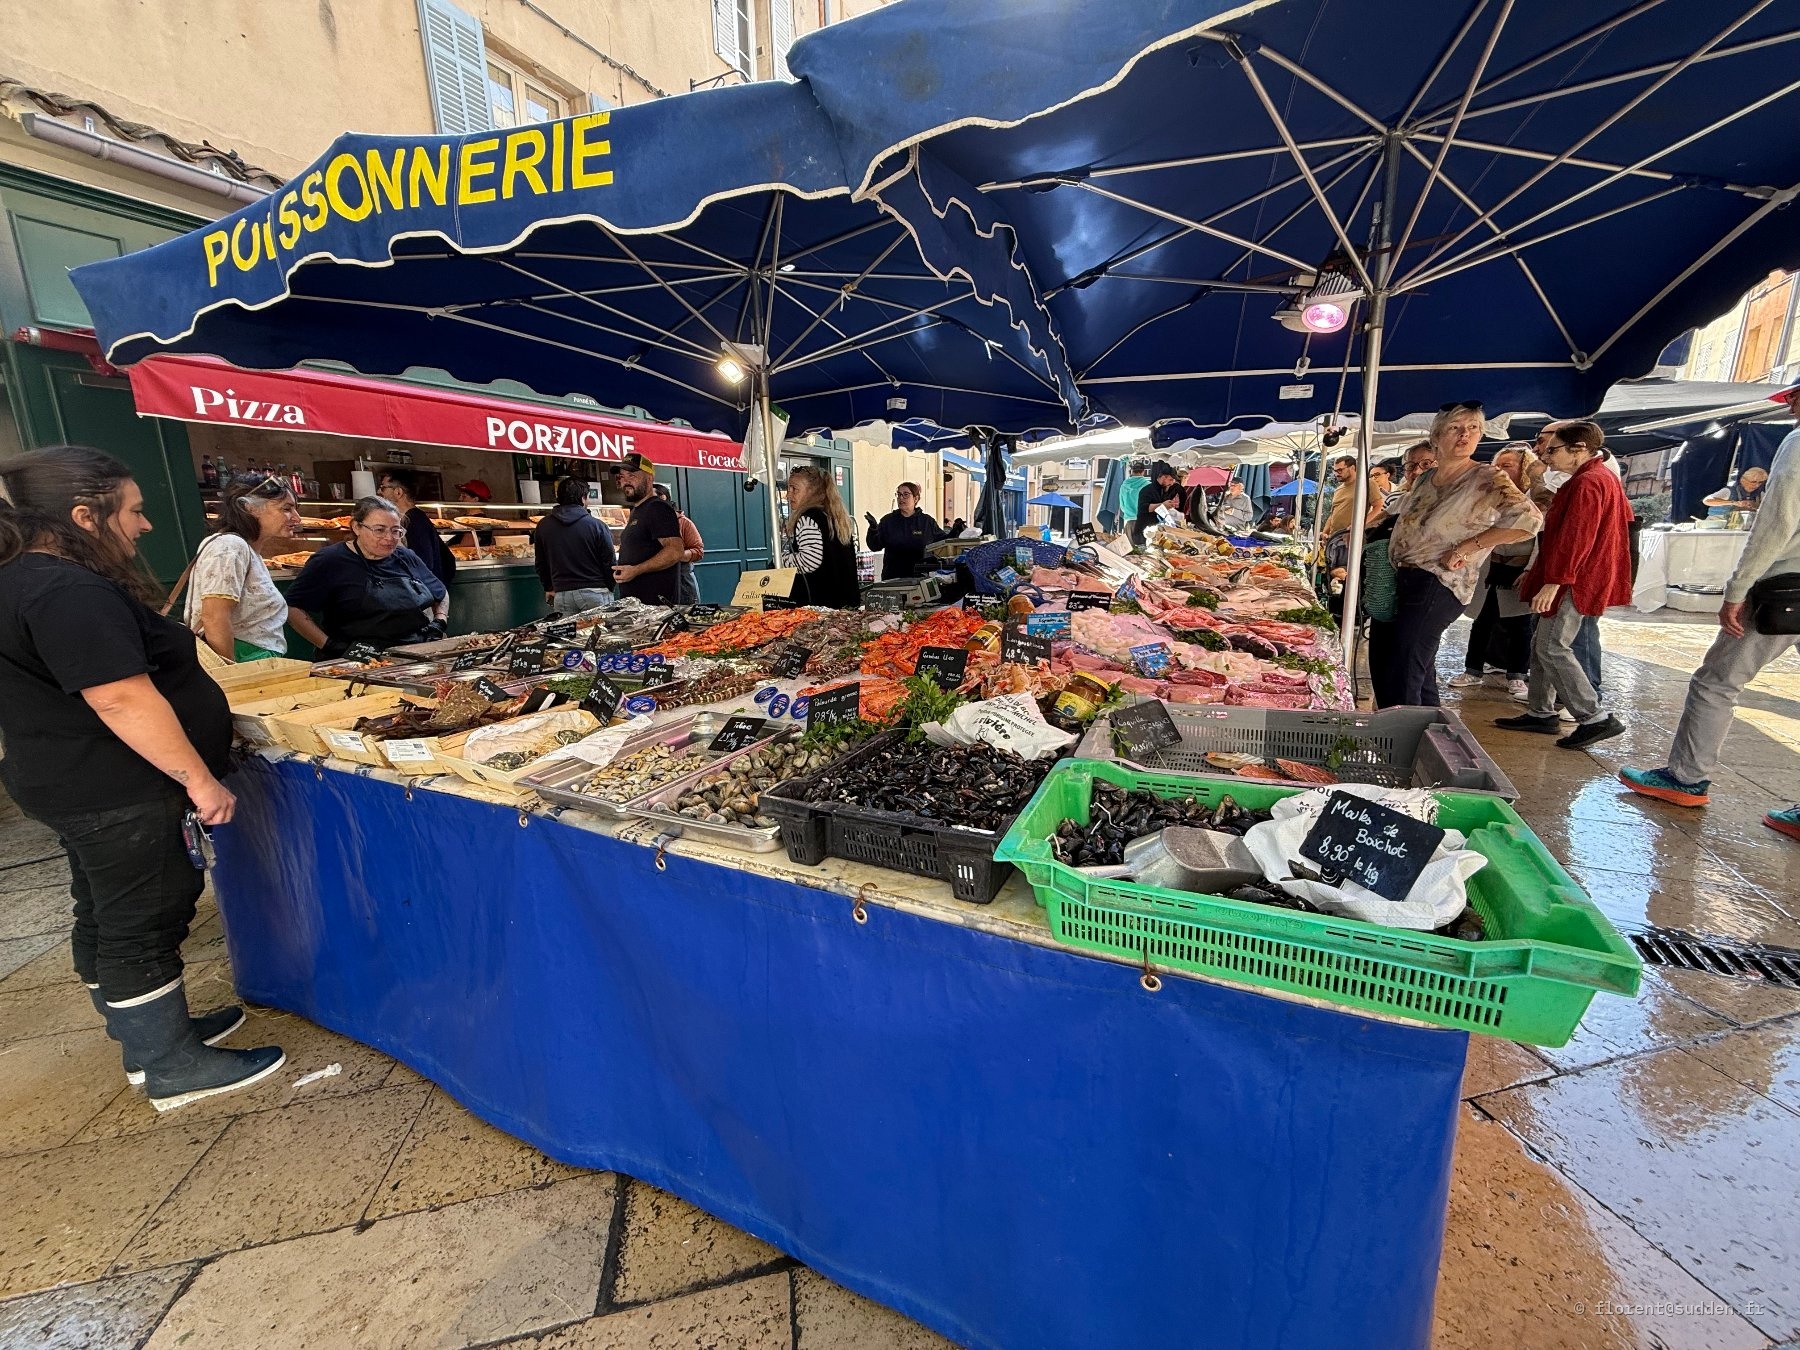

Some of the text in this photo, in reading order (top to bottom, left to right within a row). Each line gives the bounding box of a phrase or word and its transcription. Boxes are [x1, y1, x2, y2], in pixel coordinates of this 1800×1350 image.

[203, 112, 614, 287] POISSONNERIE
[190, 386, 306, 425] Pizza
[1331, 799, 1373, 826] Moules
[1383, 823, 1400, 838] de
[1318, 835, 1356, 862] 8,90€
[1355, 828, 1408, 859] Bouchot
